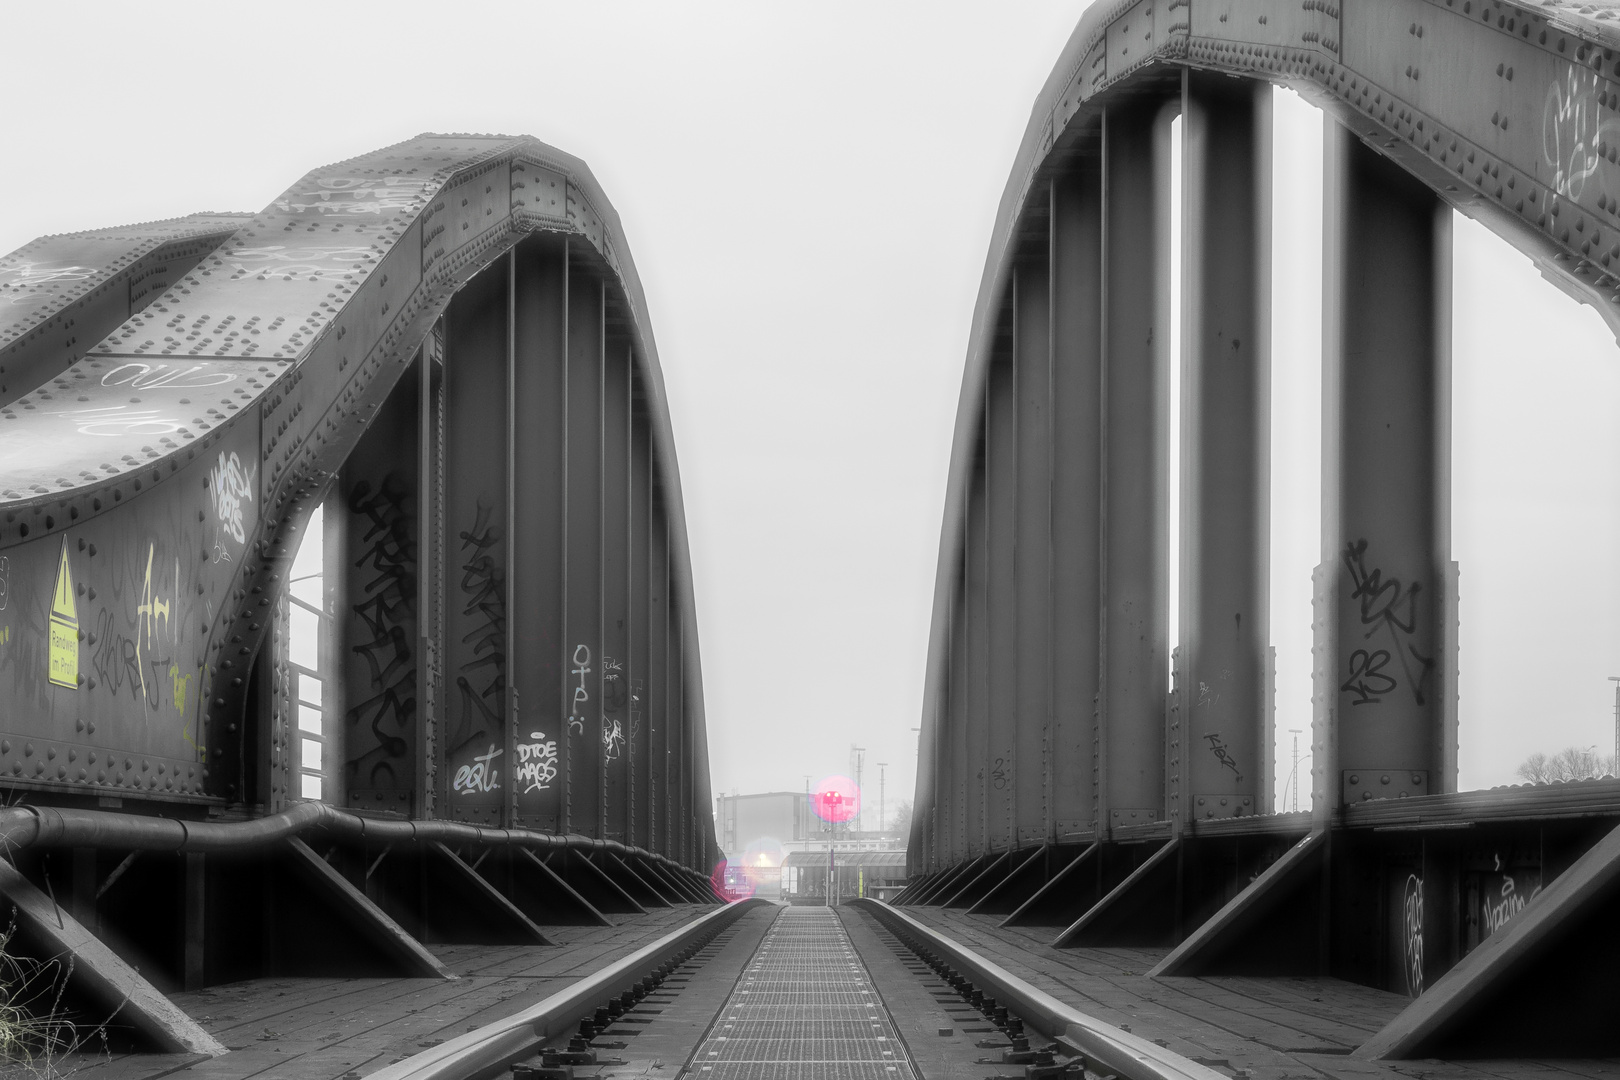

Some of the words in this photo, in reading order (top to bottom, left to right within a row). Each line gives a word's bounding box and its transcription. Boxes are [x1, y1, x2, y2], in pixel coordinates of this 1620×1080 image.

[52, 630, 76, 657] Randweg
[52, 654, 60, 672] im
[60, 657, 76, 677] Profil
